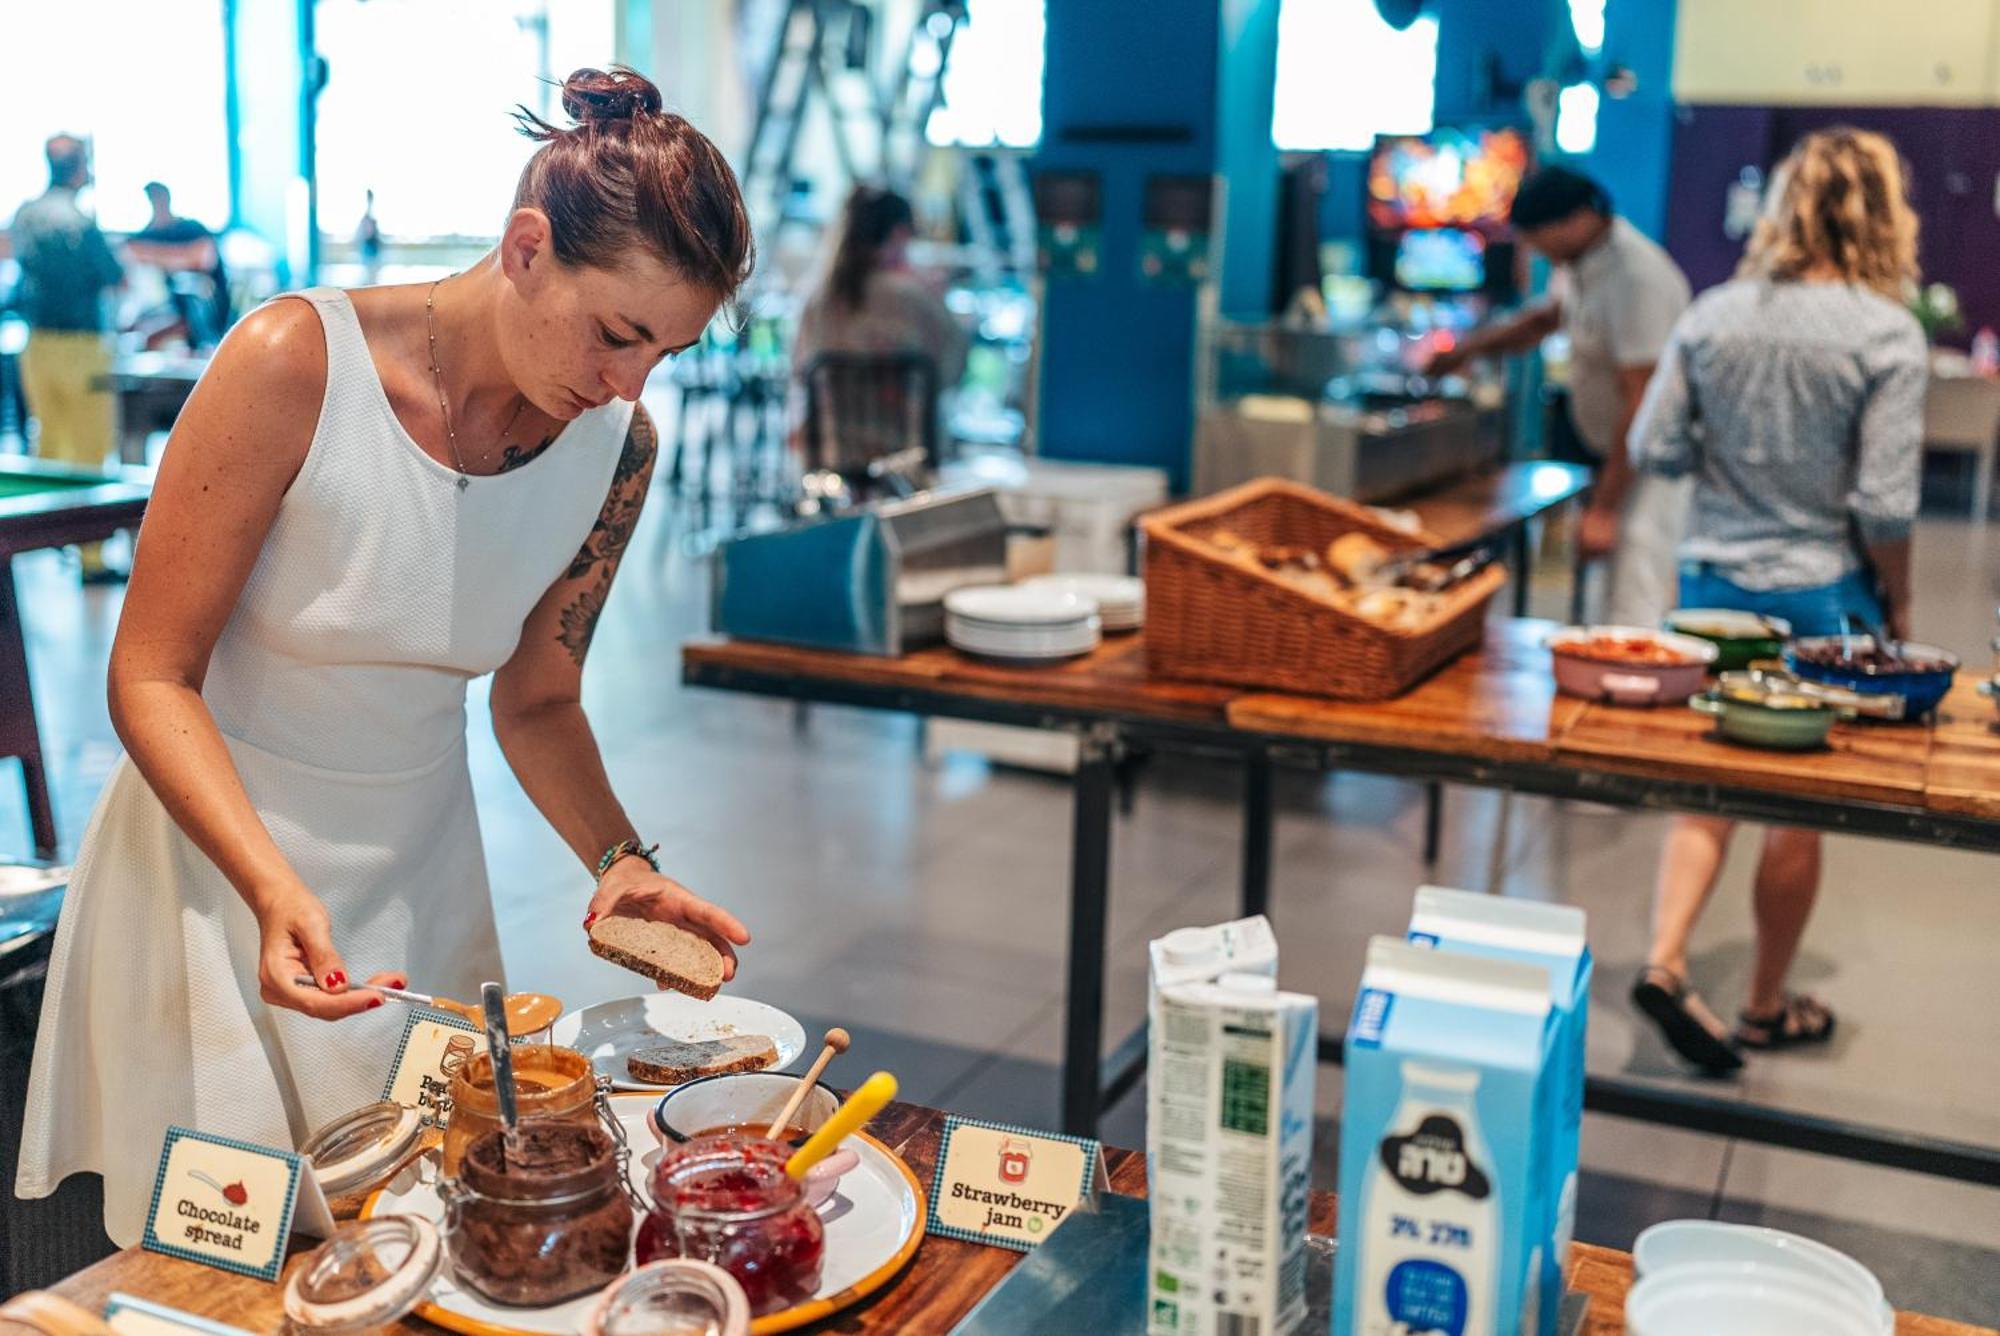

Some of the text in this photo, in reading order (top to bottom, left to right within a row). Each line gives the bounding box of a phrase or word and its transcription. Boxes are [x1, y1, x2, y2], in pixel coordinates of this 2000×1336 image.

[176, 1198, 261, 1235] Chocolate
[951, 1182, 1067, 1221] Strawberry
[984, 1207, 1023, 1229] jam
[184, 1223, 243, 1251] spread
